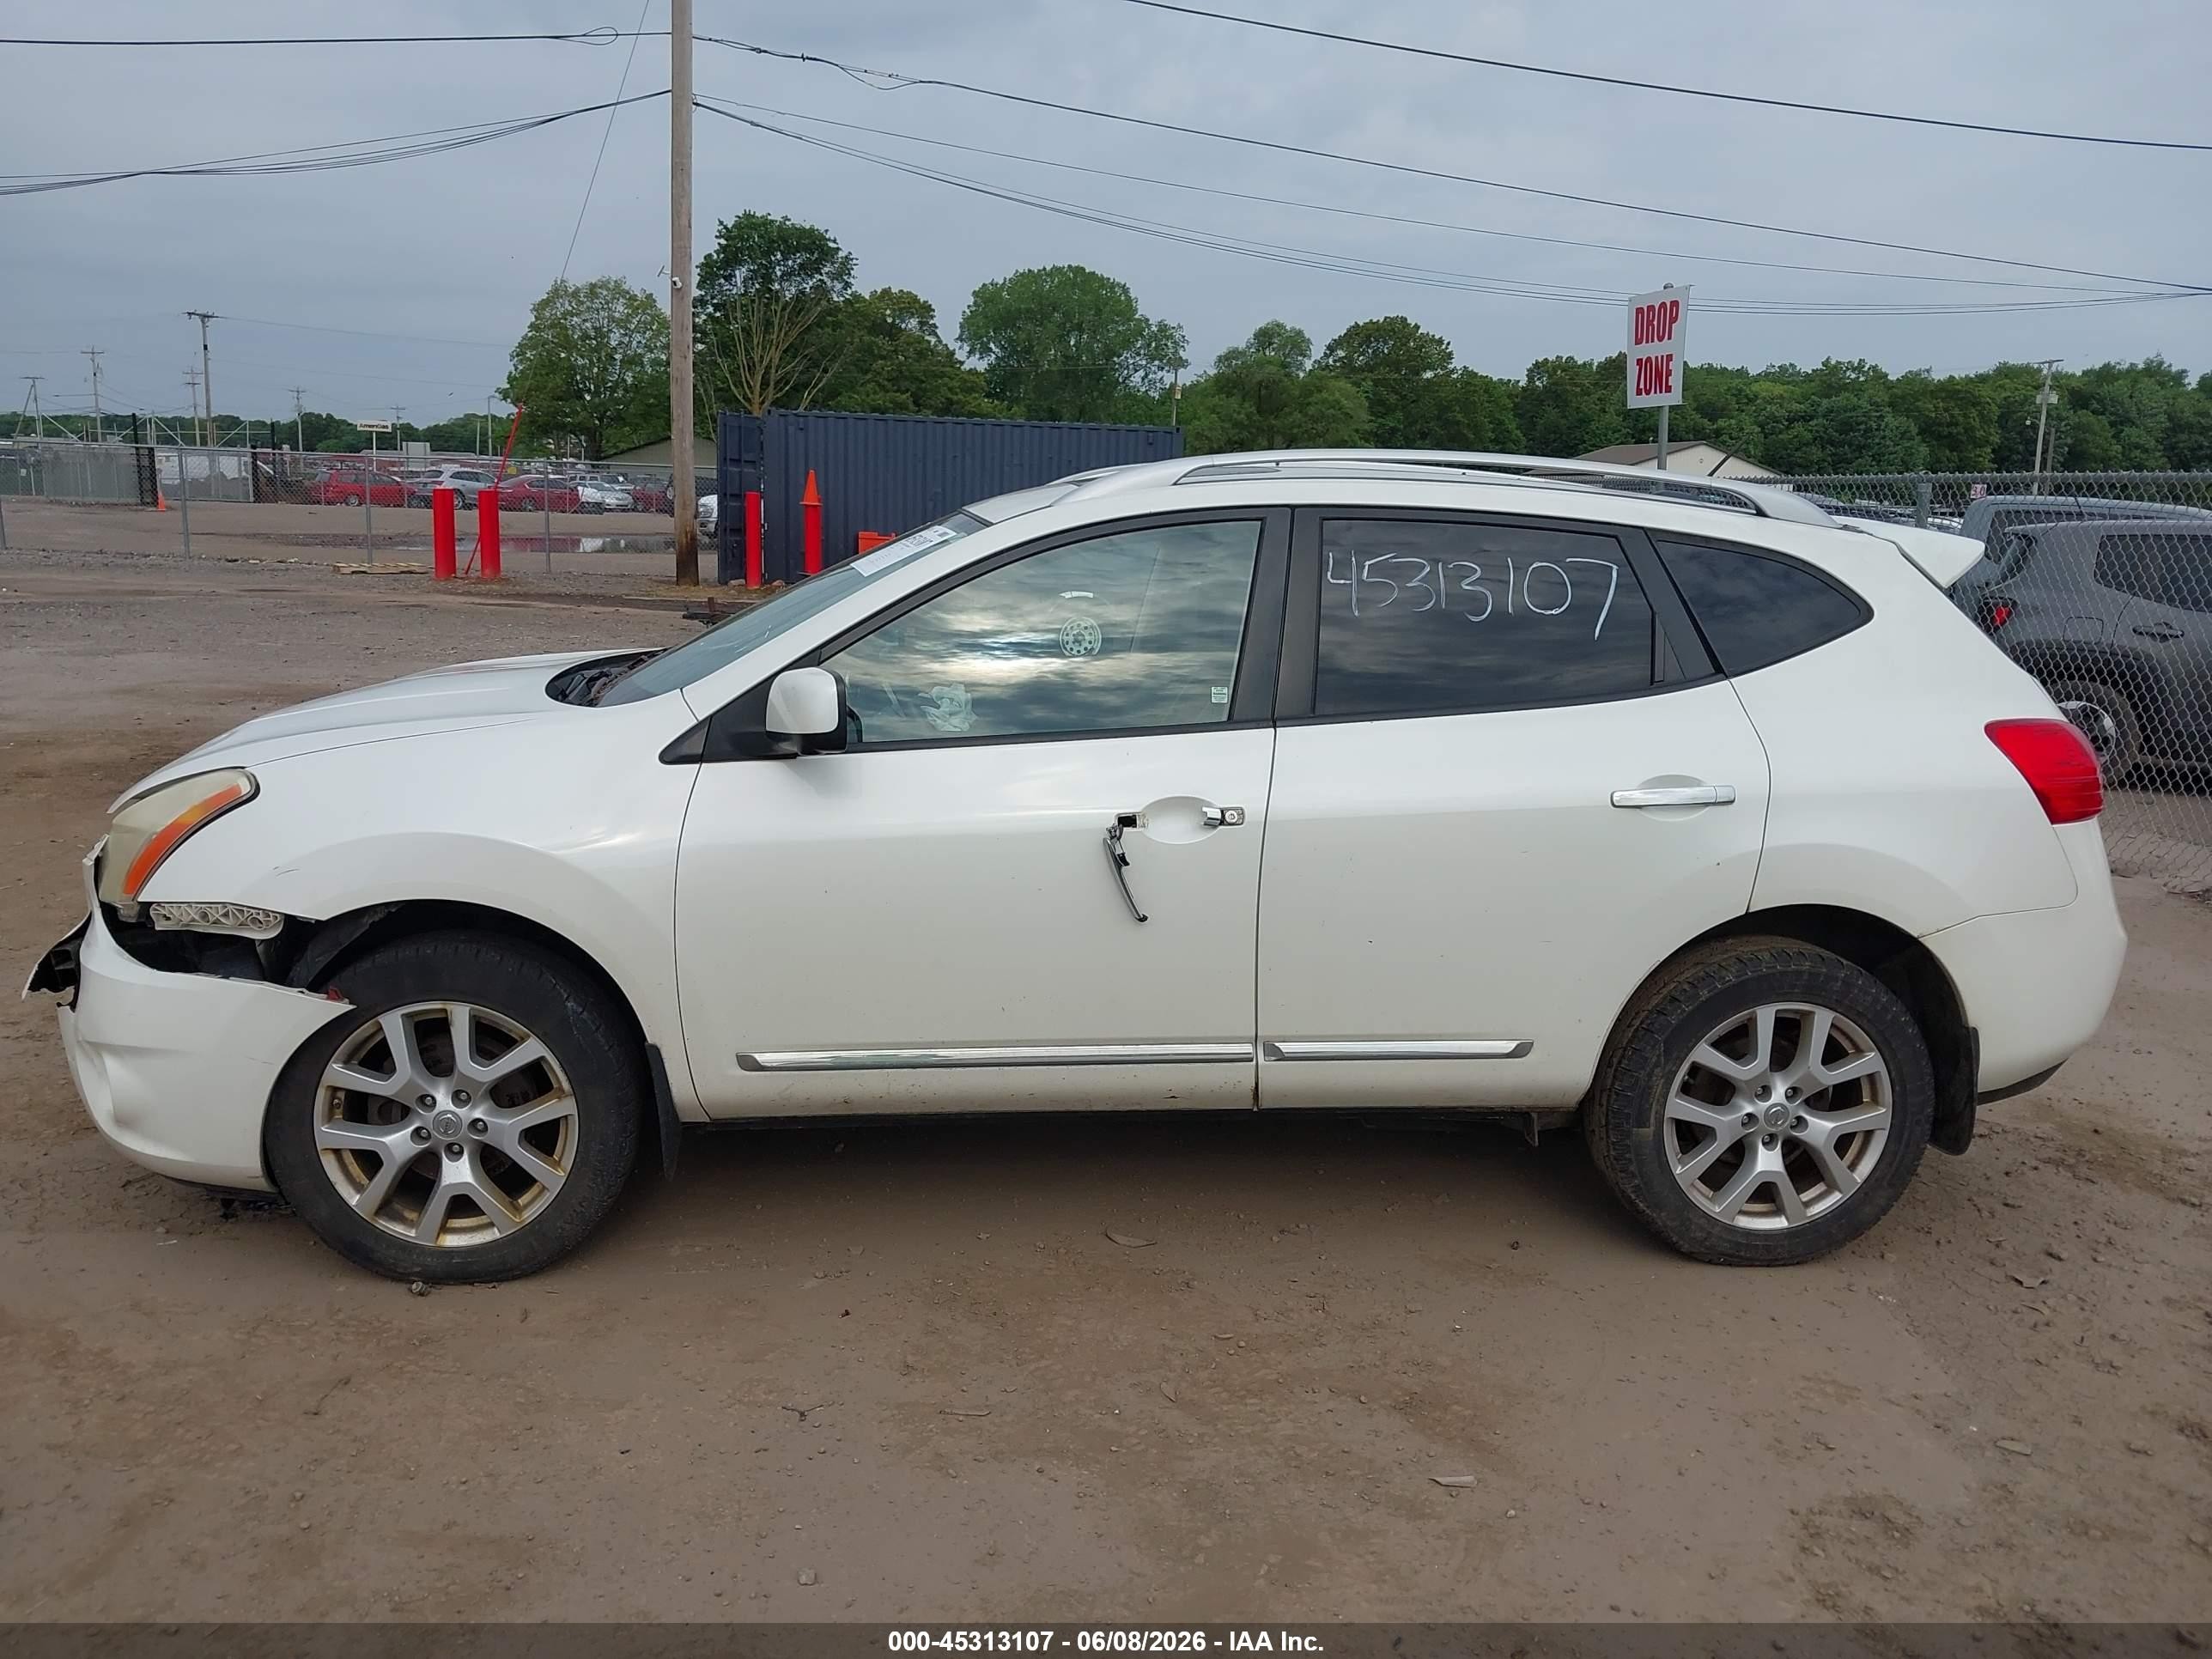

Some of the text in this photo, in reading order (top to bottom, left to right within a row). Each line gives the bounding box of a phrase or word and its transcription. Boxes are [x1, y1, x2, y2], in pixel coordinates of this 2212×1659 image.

[1635, 300, 1680, 345] DROP
[1636, 354, 1673, 396] ZONE
[1327, 550, 1619, 641] 45313107
